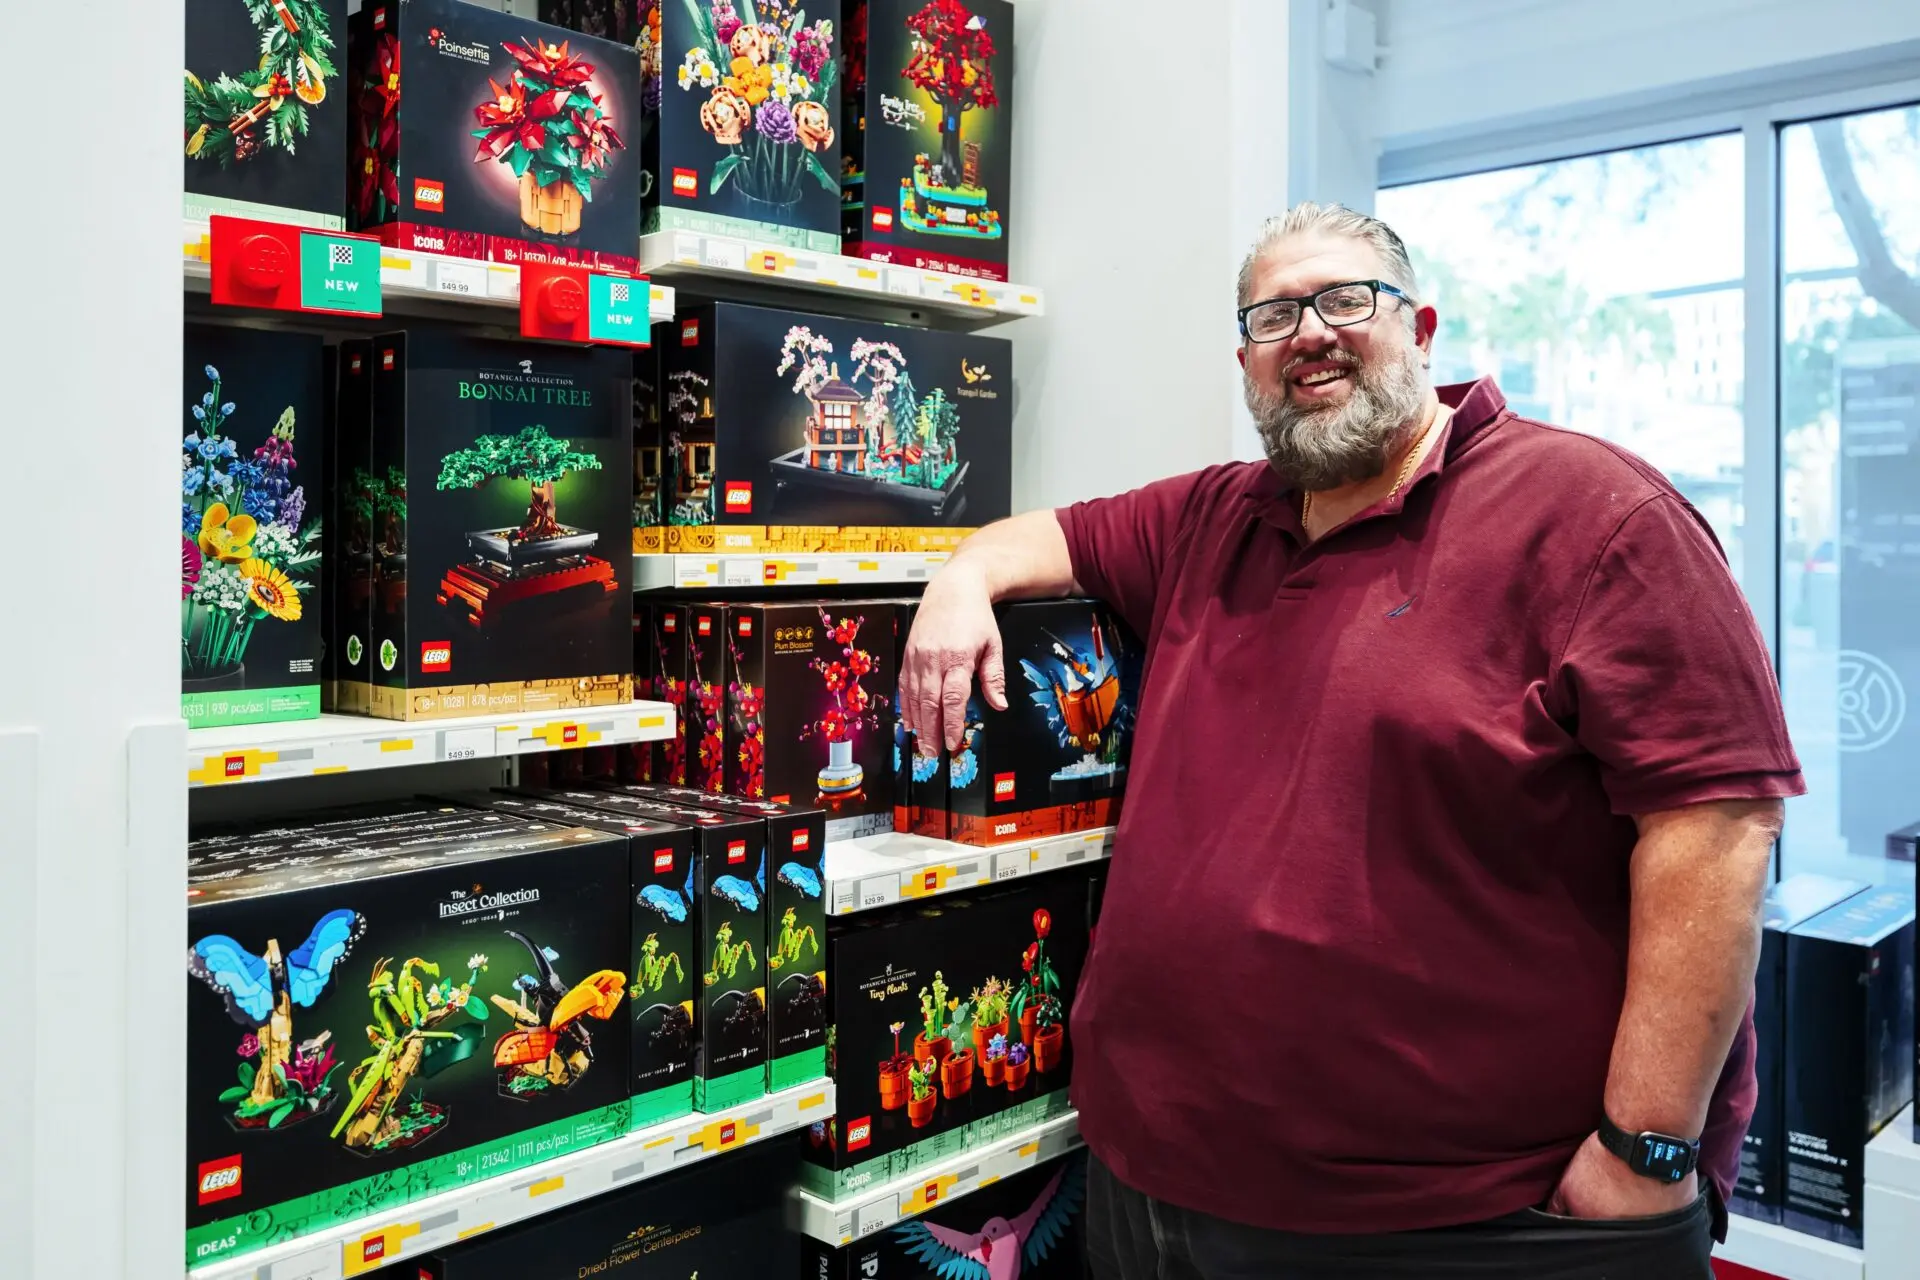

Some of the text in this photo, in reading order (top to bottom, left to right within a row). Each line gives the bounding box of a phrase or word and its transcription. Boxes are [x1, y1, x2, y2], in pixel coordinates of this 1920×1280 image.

[439, 38, 490, 61] Poinsettia
[415, 186, 443, 204] LEGO
[504, 248, 517, 261] 18+
[325, 279, 359, 293] NEW
[441, 282, 469, 293] $49.99
[607, 313, 633, 325] NEW
[479, 371, 574, 387] BOTANICAL COLLECTION
[458, 381, 593, 407] BONSAI TREE
[726, 488, 752, 505] LEGO
[422, 649, 451, 665] LEGO
[421, 699, 436, 710] 18+
[442, 695, 465, 709] 10281
[471, 693, 487, 707] 878
[182, 703, 205, 718] 0313
[211, 702, 229, 715] 939
[448, 750, 475, 760] $49.99
[227, 761, 243, 771] LEGO
[995, 779, 1015, 794] LEGO
[654, 854, 673, 867] LEGO
[440, 888, 540, 917] Insect Collection
[450, 890, 467, 900] The
[864, 895, 885, 906] $29.99
[887, 970, 917, 983] COLLECTION
[869, 980, 909, 1002] Tiny Plants
[848, 1124, 871, 1144] LEGO
[456, 1133, 569, 1177] 18+ 21342 1111 pcs/pzs
[200, 1166, 242, 1193] LEGO
[861, 1220, 884, 1235] $49.99
[196, 1235, 237, 1257] IDEAS
[364, 1242, 383, 1256] LEGO
[578, 1225, 702, 1279] Dried Flower Centerpiece
